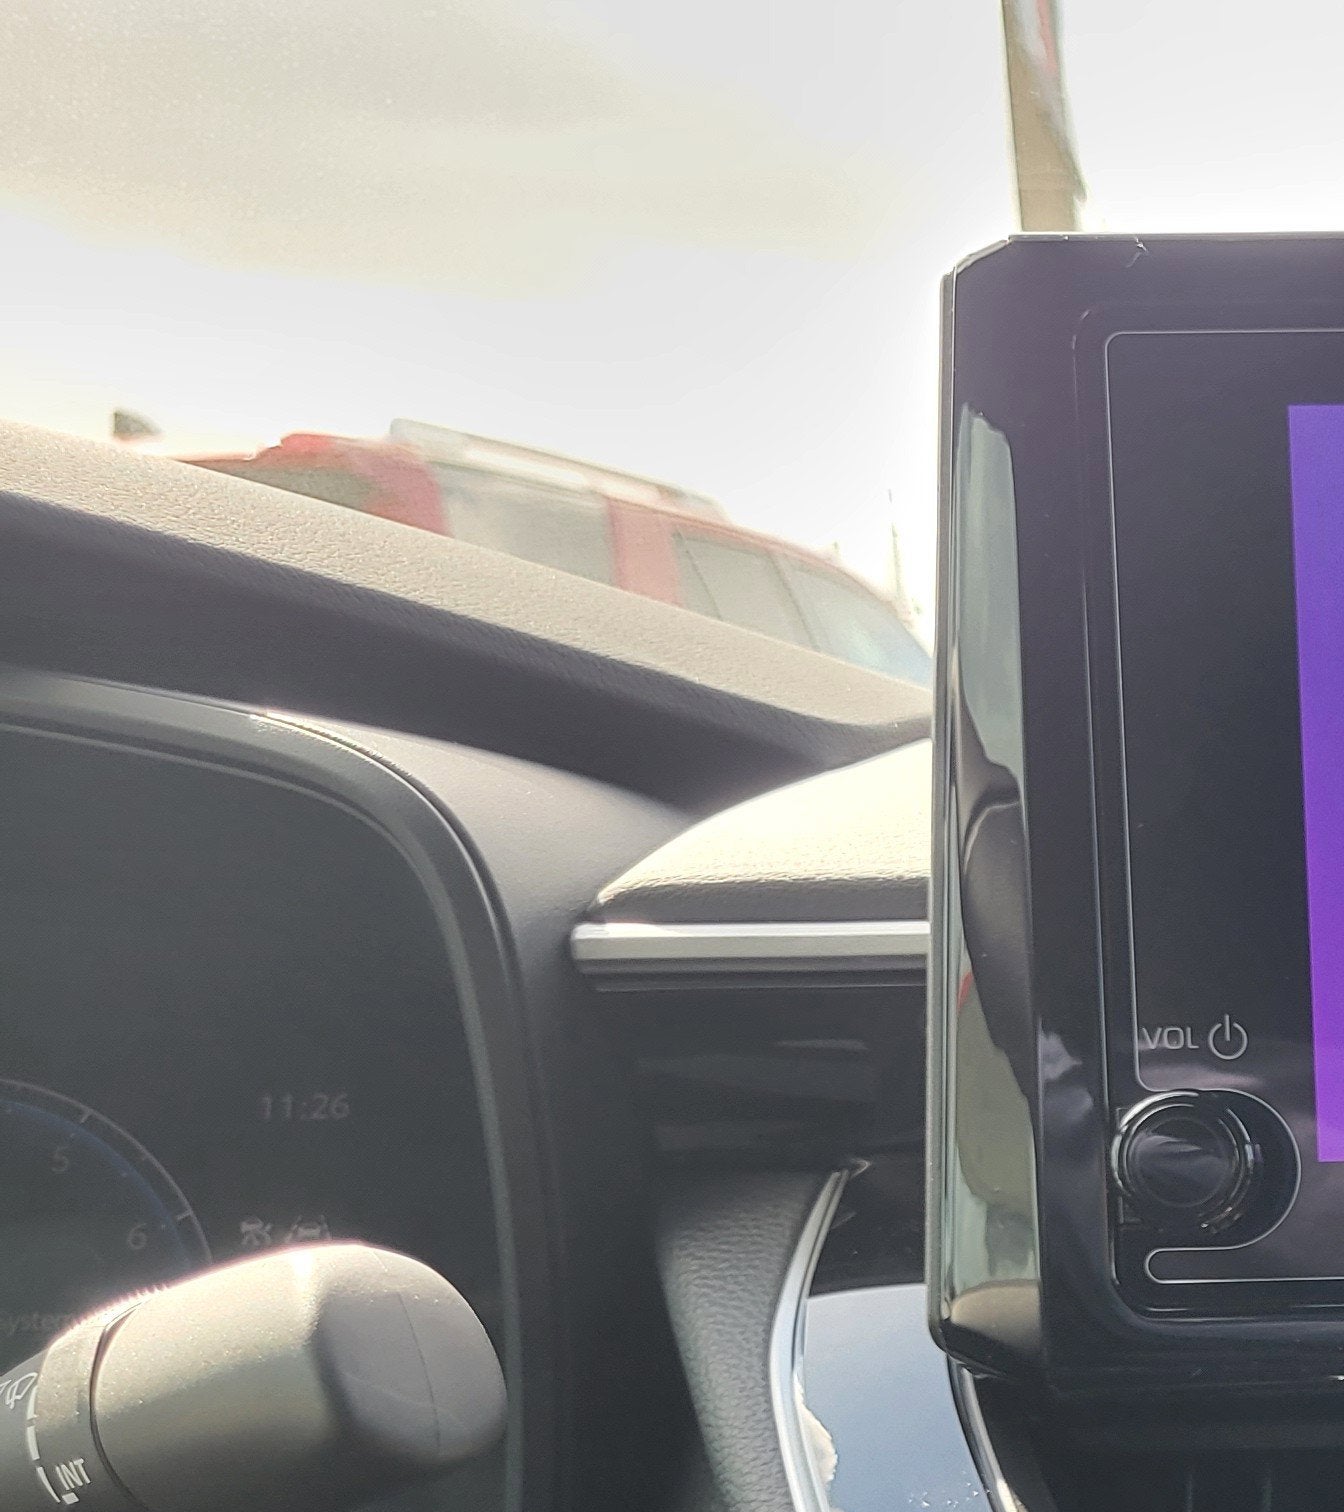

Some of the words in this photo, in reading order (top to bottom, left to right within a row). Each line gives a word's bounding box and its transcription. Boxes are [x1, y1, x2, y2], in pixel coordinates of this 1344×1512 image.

[1141, 1027, 1200, 1050] VOL
[260, 1093, 350, 1121] 11:26
[51, 1149, 70, 1173] 5
[127, 1224, 148, 1250] 6
[55, 1457, 91, 1491] INT
